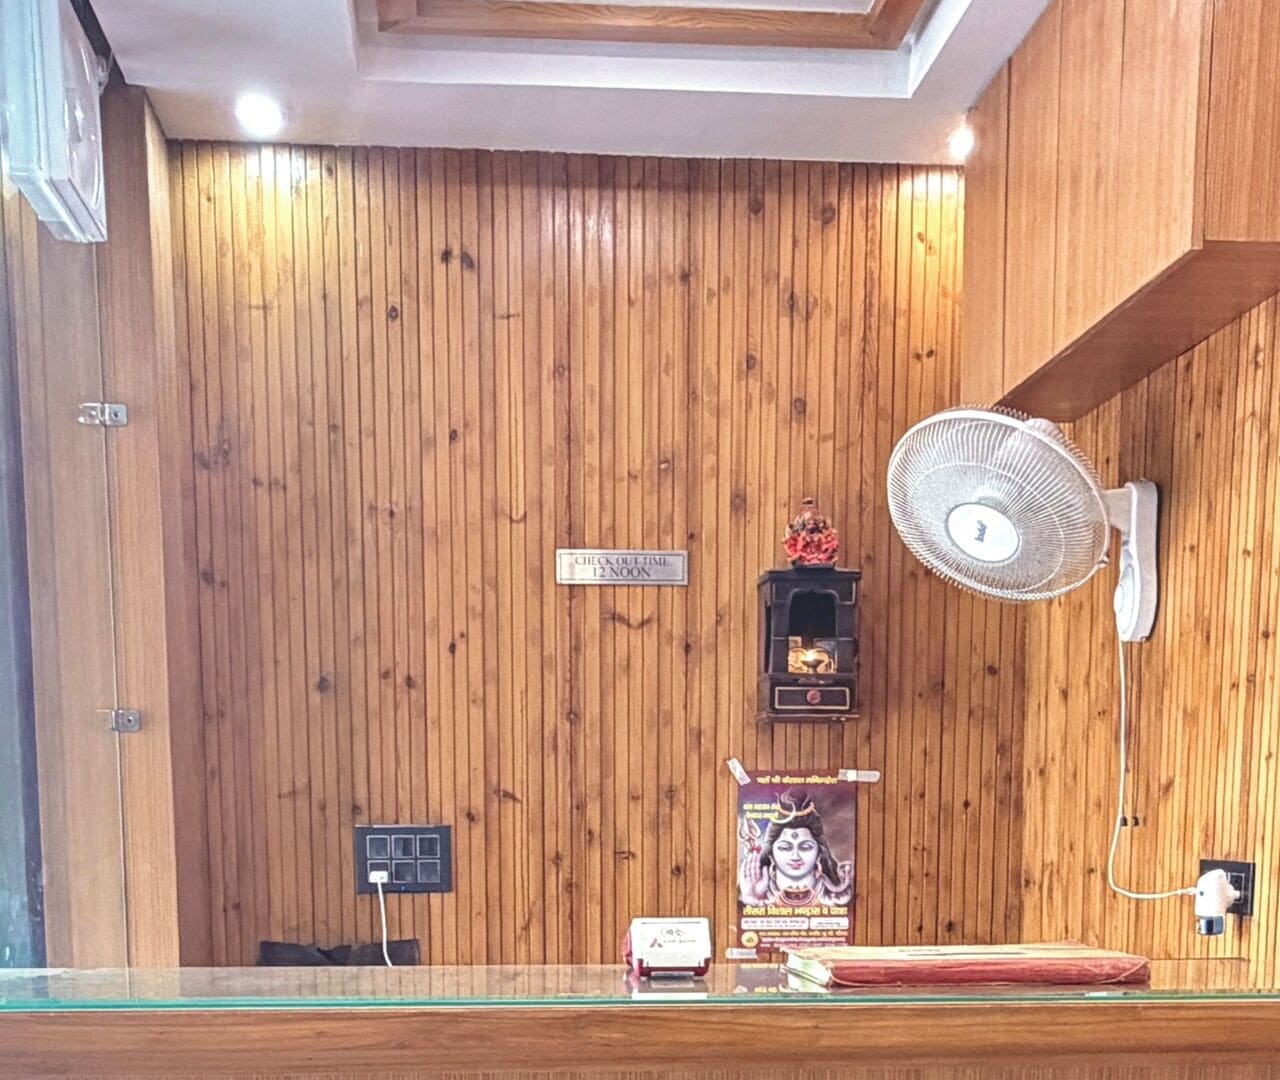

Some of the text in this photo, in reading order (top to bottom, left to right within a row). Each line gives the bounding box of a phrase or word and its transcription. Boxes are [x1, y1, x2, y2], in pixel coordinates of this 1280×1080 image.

[575, 556, 669, 567] CHECK OUT TIME
[593, 567, 651, 578] 12 NOON
